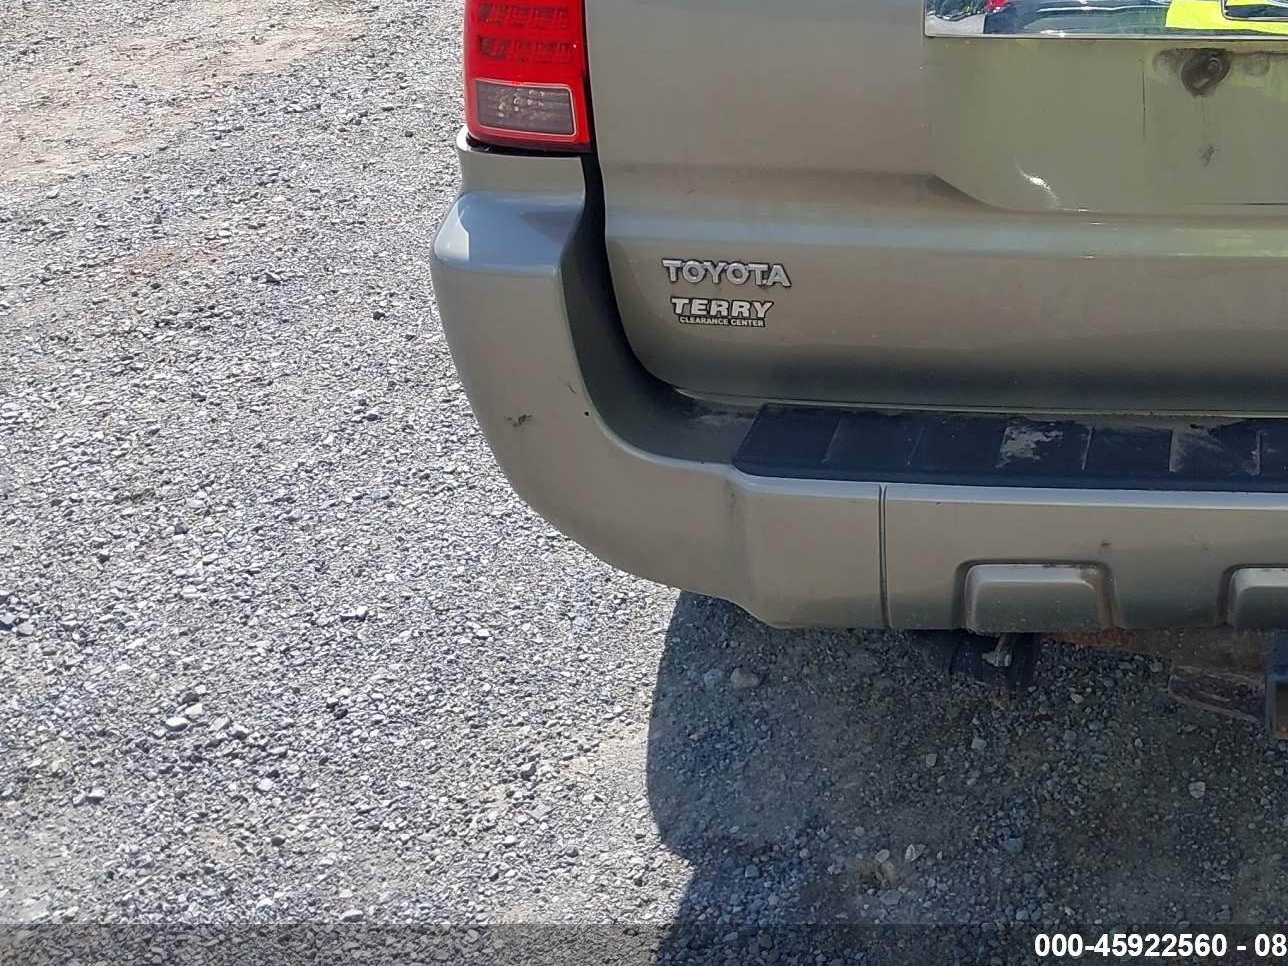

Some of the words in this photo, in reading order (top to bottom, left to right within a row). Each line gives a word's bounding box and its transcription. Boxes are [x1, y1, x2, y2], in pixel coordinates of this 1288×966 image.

[662, 258, 792, 287] TOYOTA
[671, 296, 774, 319] TERRY
[679, 315, 729, 325] CLEARANCE
[730, 318, 765, 327] CENTER
